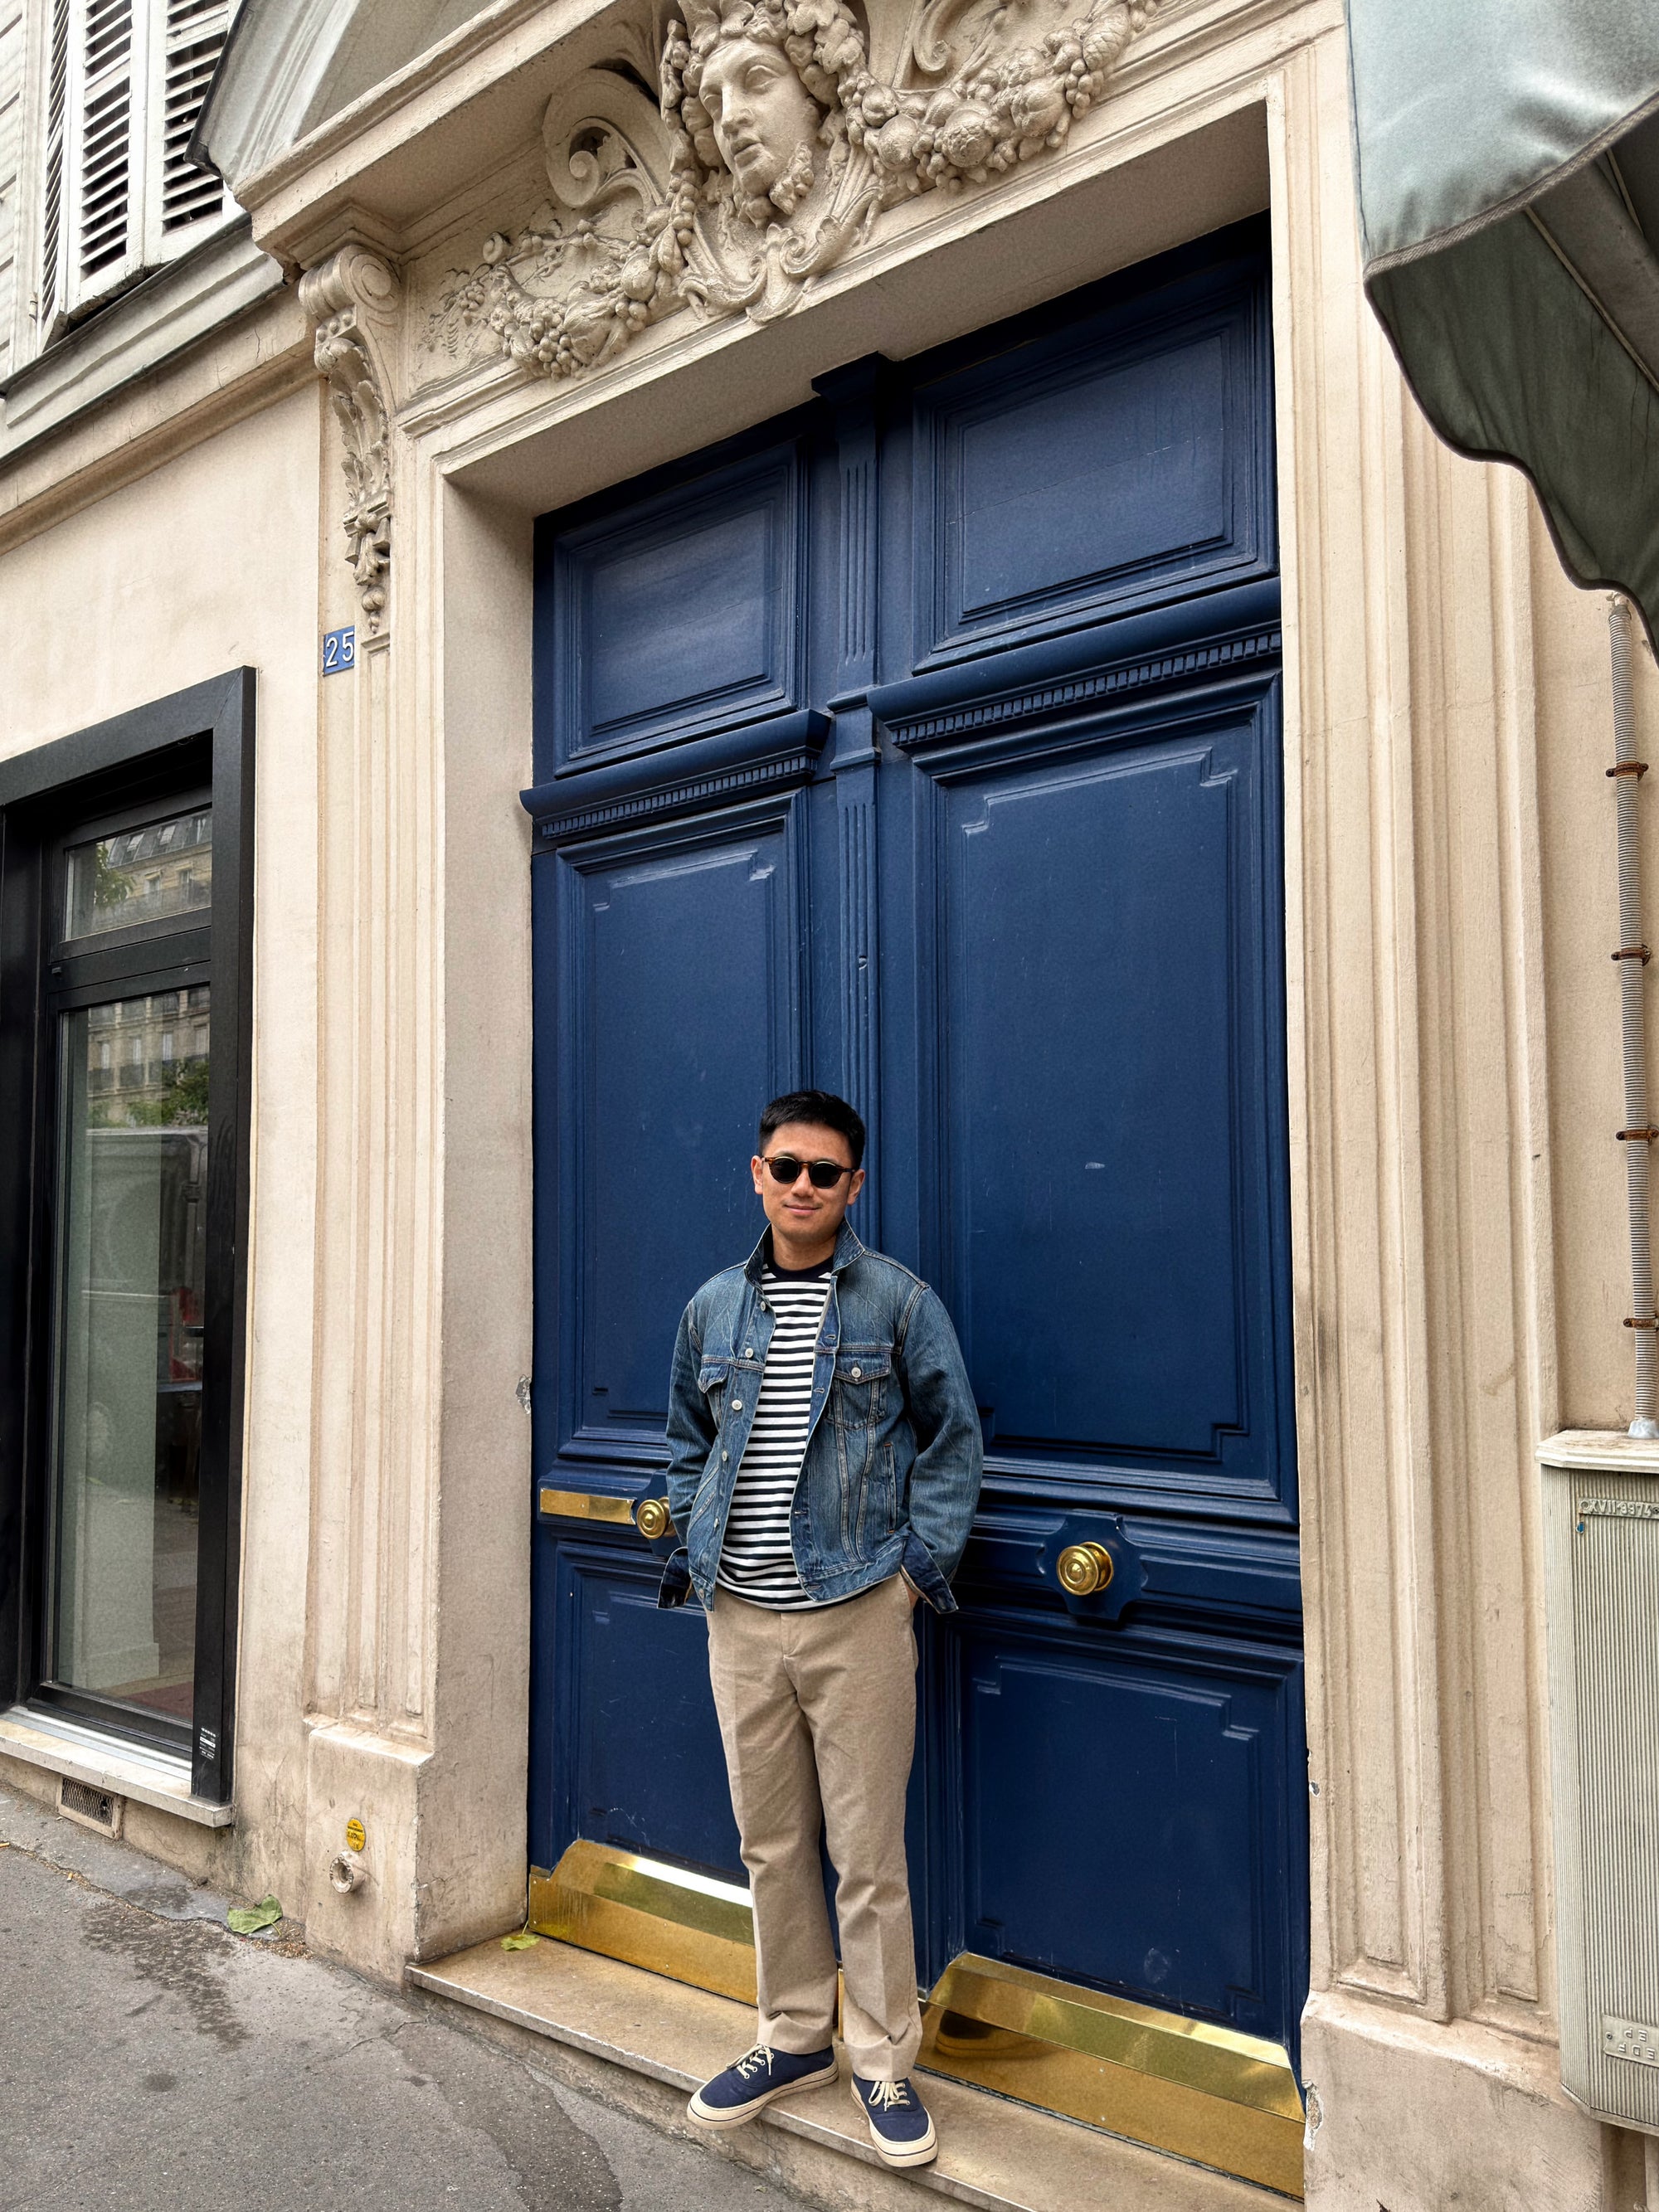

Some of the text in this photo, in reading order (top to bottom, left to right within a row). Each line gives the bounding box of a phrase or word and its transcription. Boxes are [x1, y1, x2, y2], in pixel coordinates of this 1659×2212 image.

[326, 630, 354, 668] 25
[1623, 2027, 1647, 2042] EP
[1618, 2042, 1656, 2061] EDF
